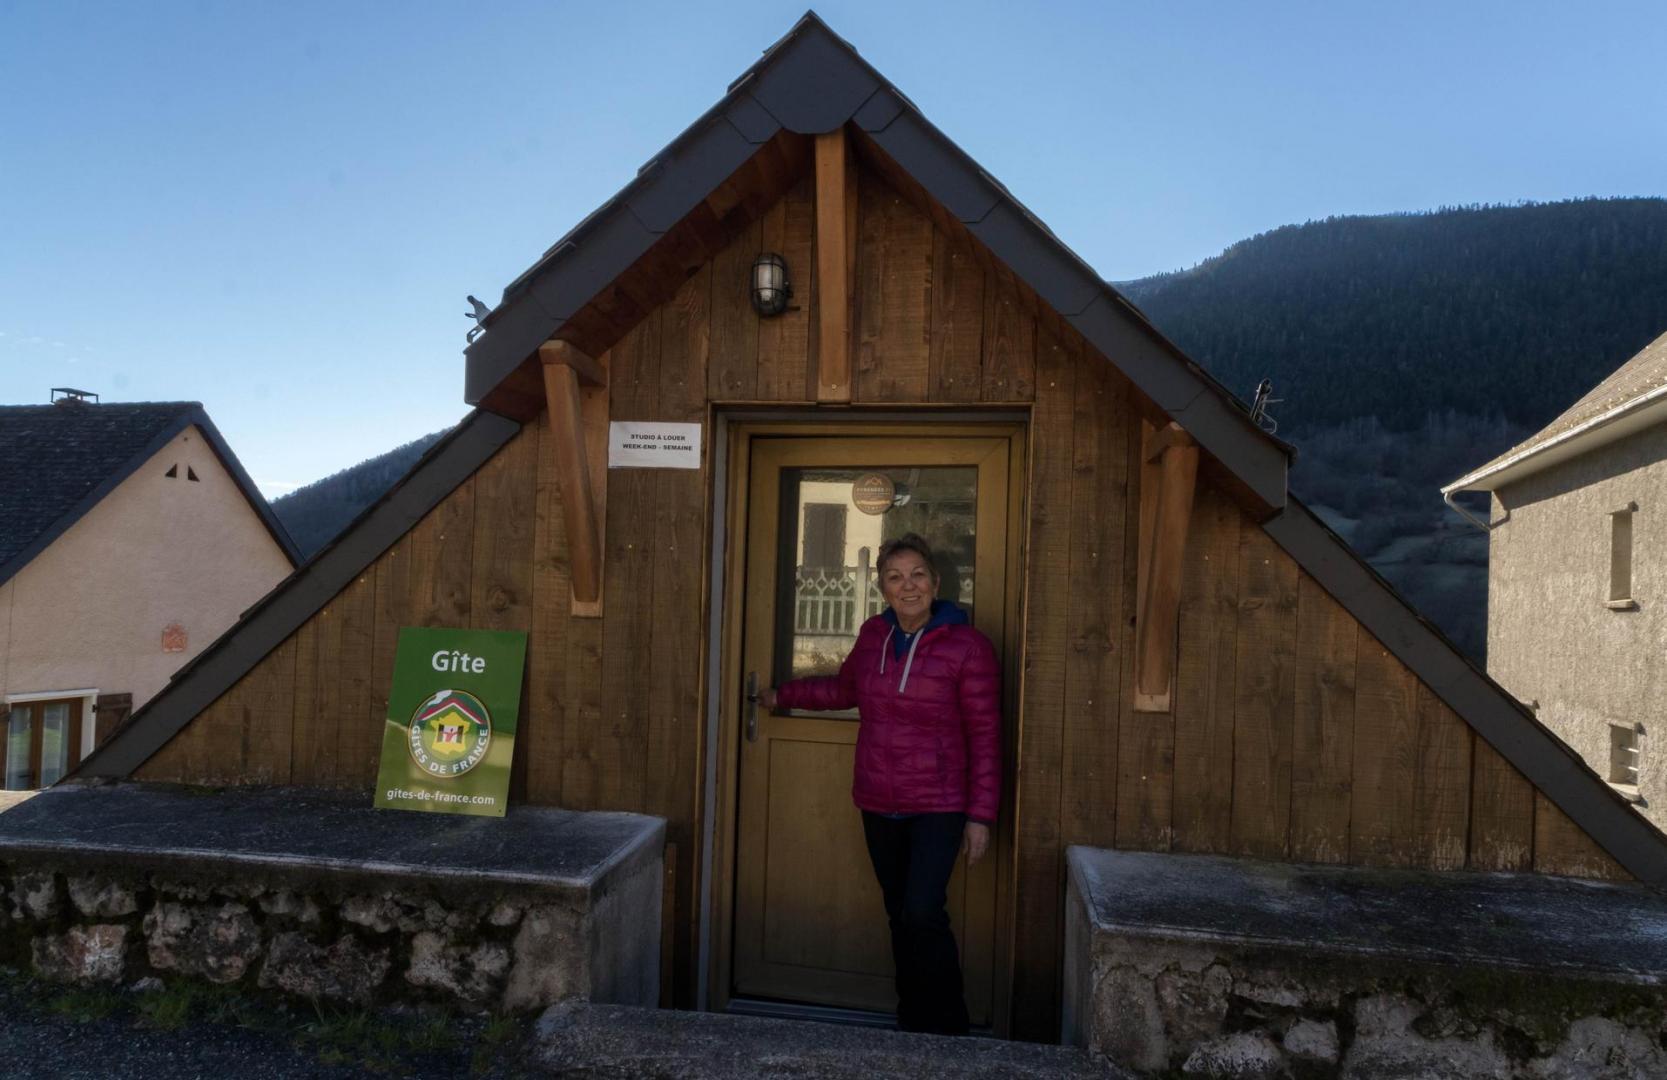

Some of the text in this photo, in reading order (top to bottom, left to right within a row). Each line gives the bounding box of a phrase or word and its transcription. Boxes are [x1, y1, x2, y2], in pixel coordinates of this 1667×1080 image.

[663, 444, 693, 452] SEMAINE
[431, 650, 486, 673] Gîte
[429, 762, 447, 774] DE
[452, 728, 488, 773] FRANCE
